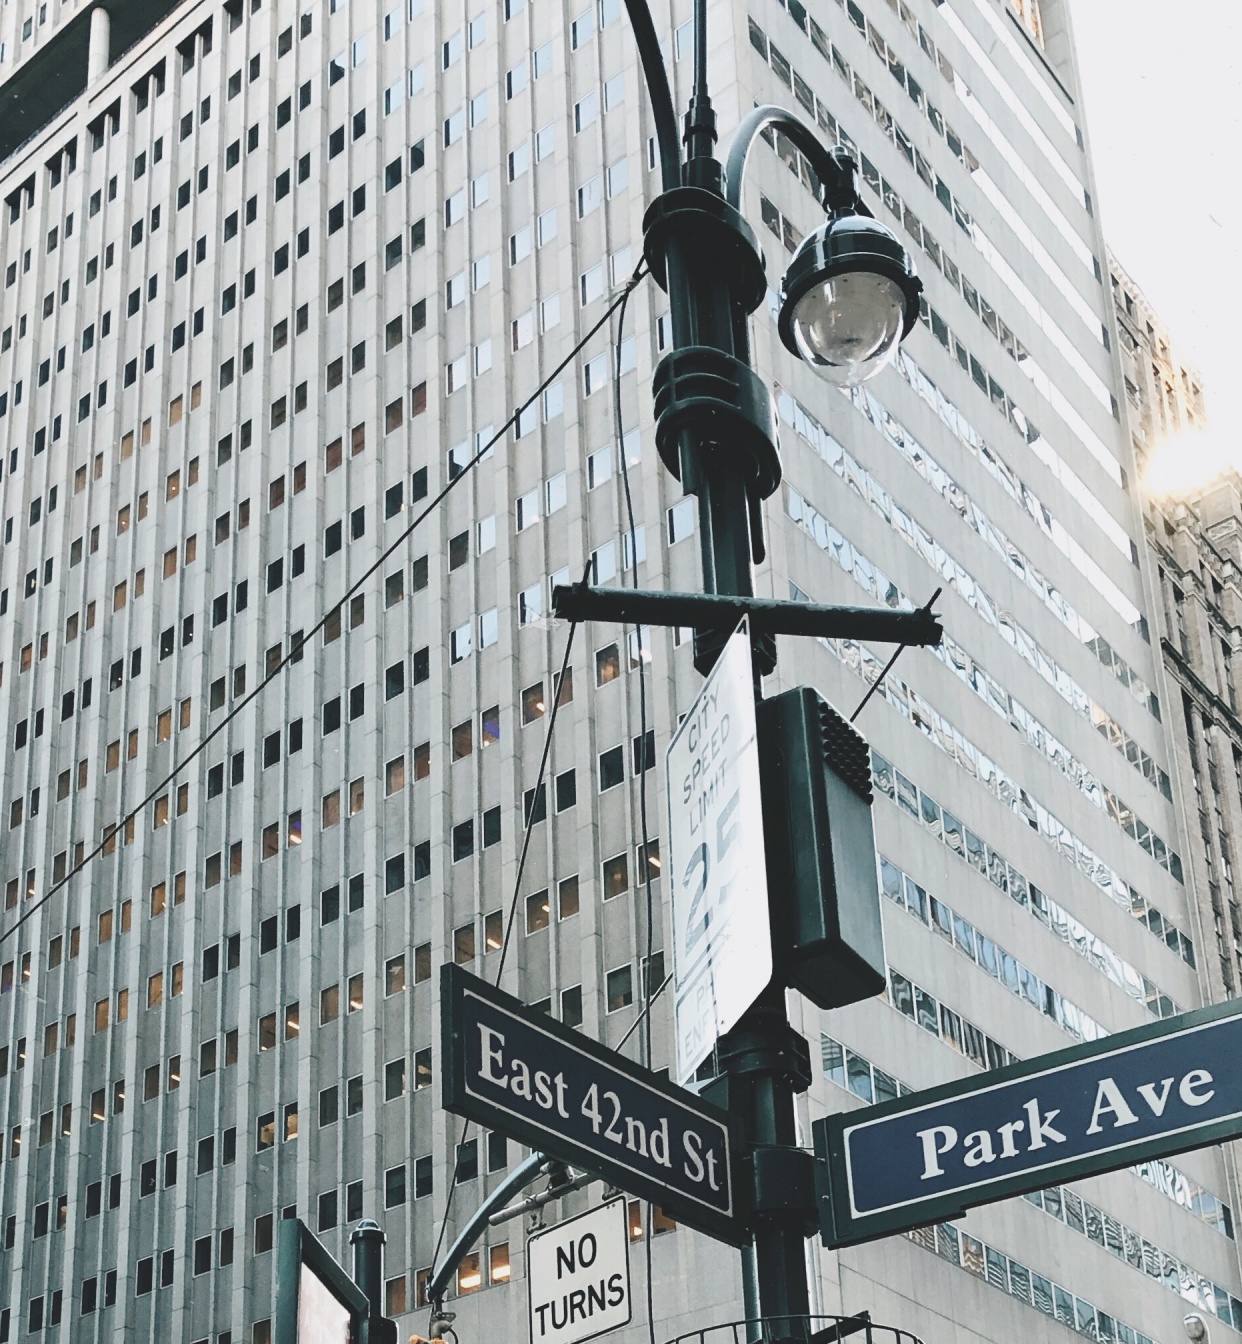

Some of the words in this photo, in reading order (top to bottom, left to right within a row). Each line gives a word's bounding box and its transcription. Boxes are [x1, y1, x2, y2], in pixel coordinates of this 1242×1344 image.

[682, 712, 731, 805] SPEED
[686, 681, 721, 754] CITY
[689, 762, 728, 837] LIMIT
[681, 787, 742, 959] 25
[476, 1022, 569, 1118] East
[581, 1083, 672, 1168] 42nd
[682, 1129, 720, 1192] St
[915, 1097, 1067, 1180] Park
[1085, 1069, 1215, 1135] Ave
[556, 1232, 597, 1280] NO
[534, 1273, 625, 1336] TURNS
